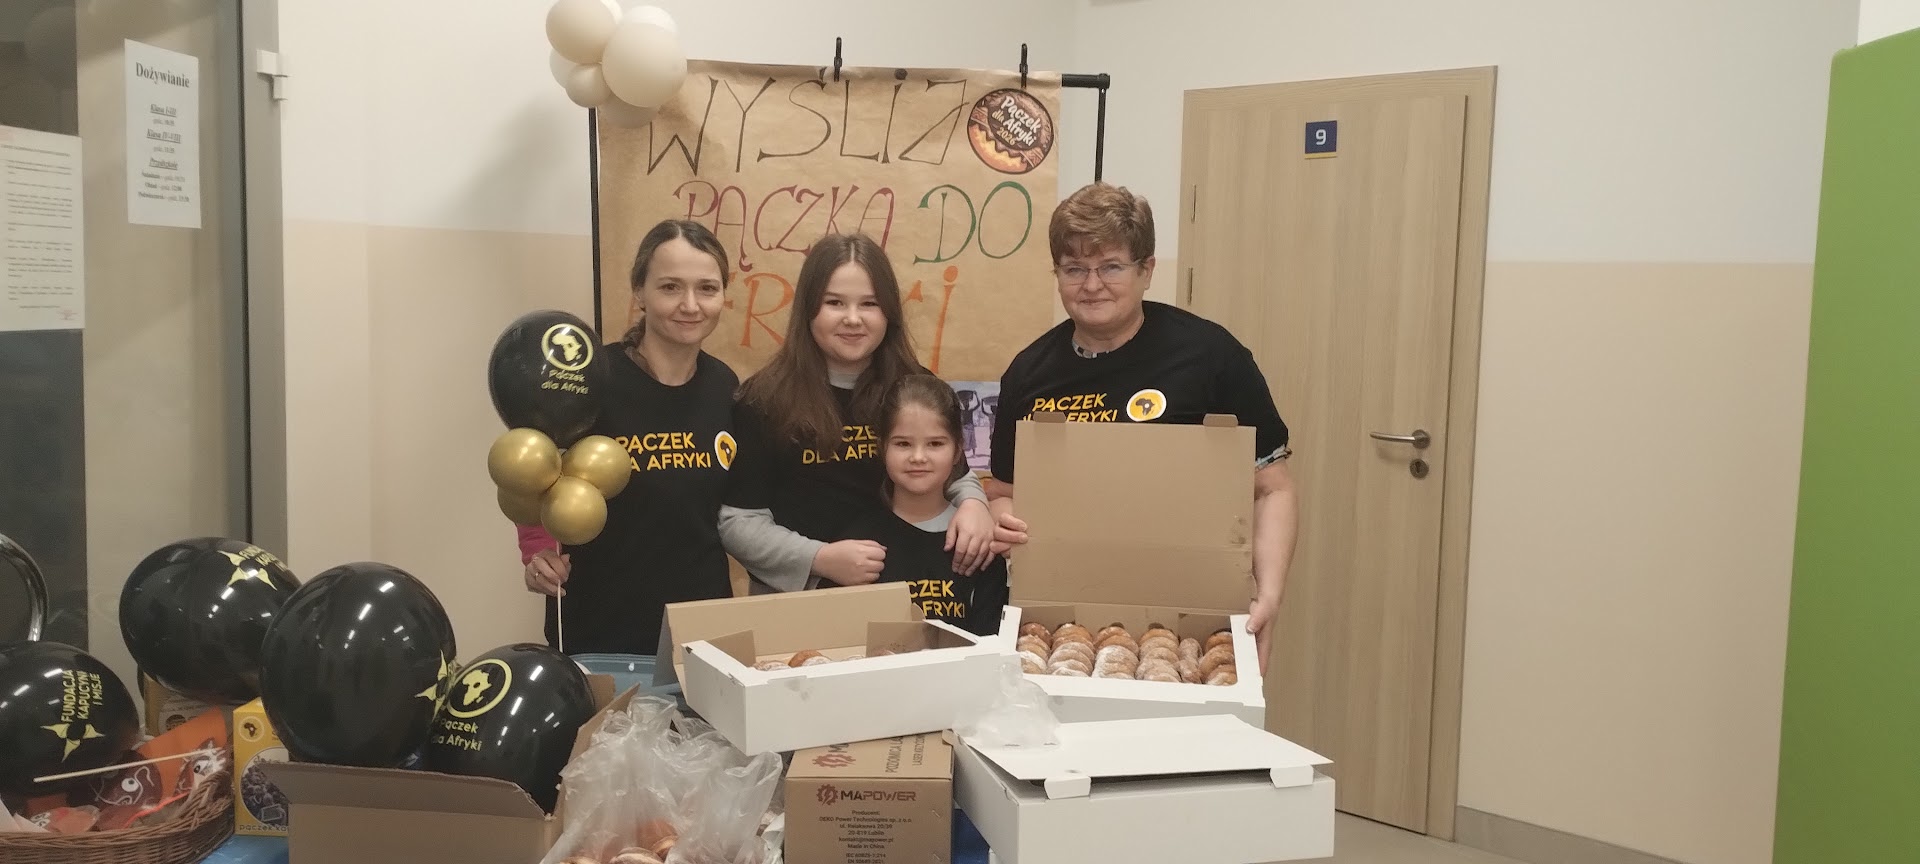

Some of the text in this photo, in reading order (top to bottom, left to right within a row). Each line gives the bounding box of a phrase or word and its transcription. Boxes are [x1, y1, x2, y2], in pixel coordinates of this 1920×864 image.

[136, 62, 190, 88] Dożywianie
[1001, 95, 1041, 133] Pączek
[992, 109, 1037, 146] dla Afryki
[997, 127, 1016, 146] 2026
[1315, 129, 1327, 145] 9
[913, 181, 1032, 264] DO
[1032, 392, 1107, 412] PĄCZEK
[1066, 409, 1118, 423] FRYKI
[646, 452, 712, 471] AFRYKI
[844, 443, 878, 461] AFR
[906, 579, 955, 599] CZEK
[922, 600, 965, 619] FRYKI
[61, 669, 77, 723] FUNDACJA
[76, 670, 91, 720] KAPUCYNI
[89, 672, 103, 700] MISJE
[446, 734, 483, 752] Afryki
[841, 790, 917, 801] MAPOWER
